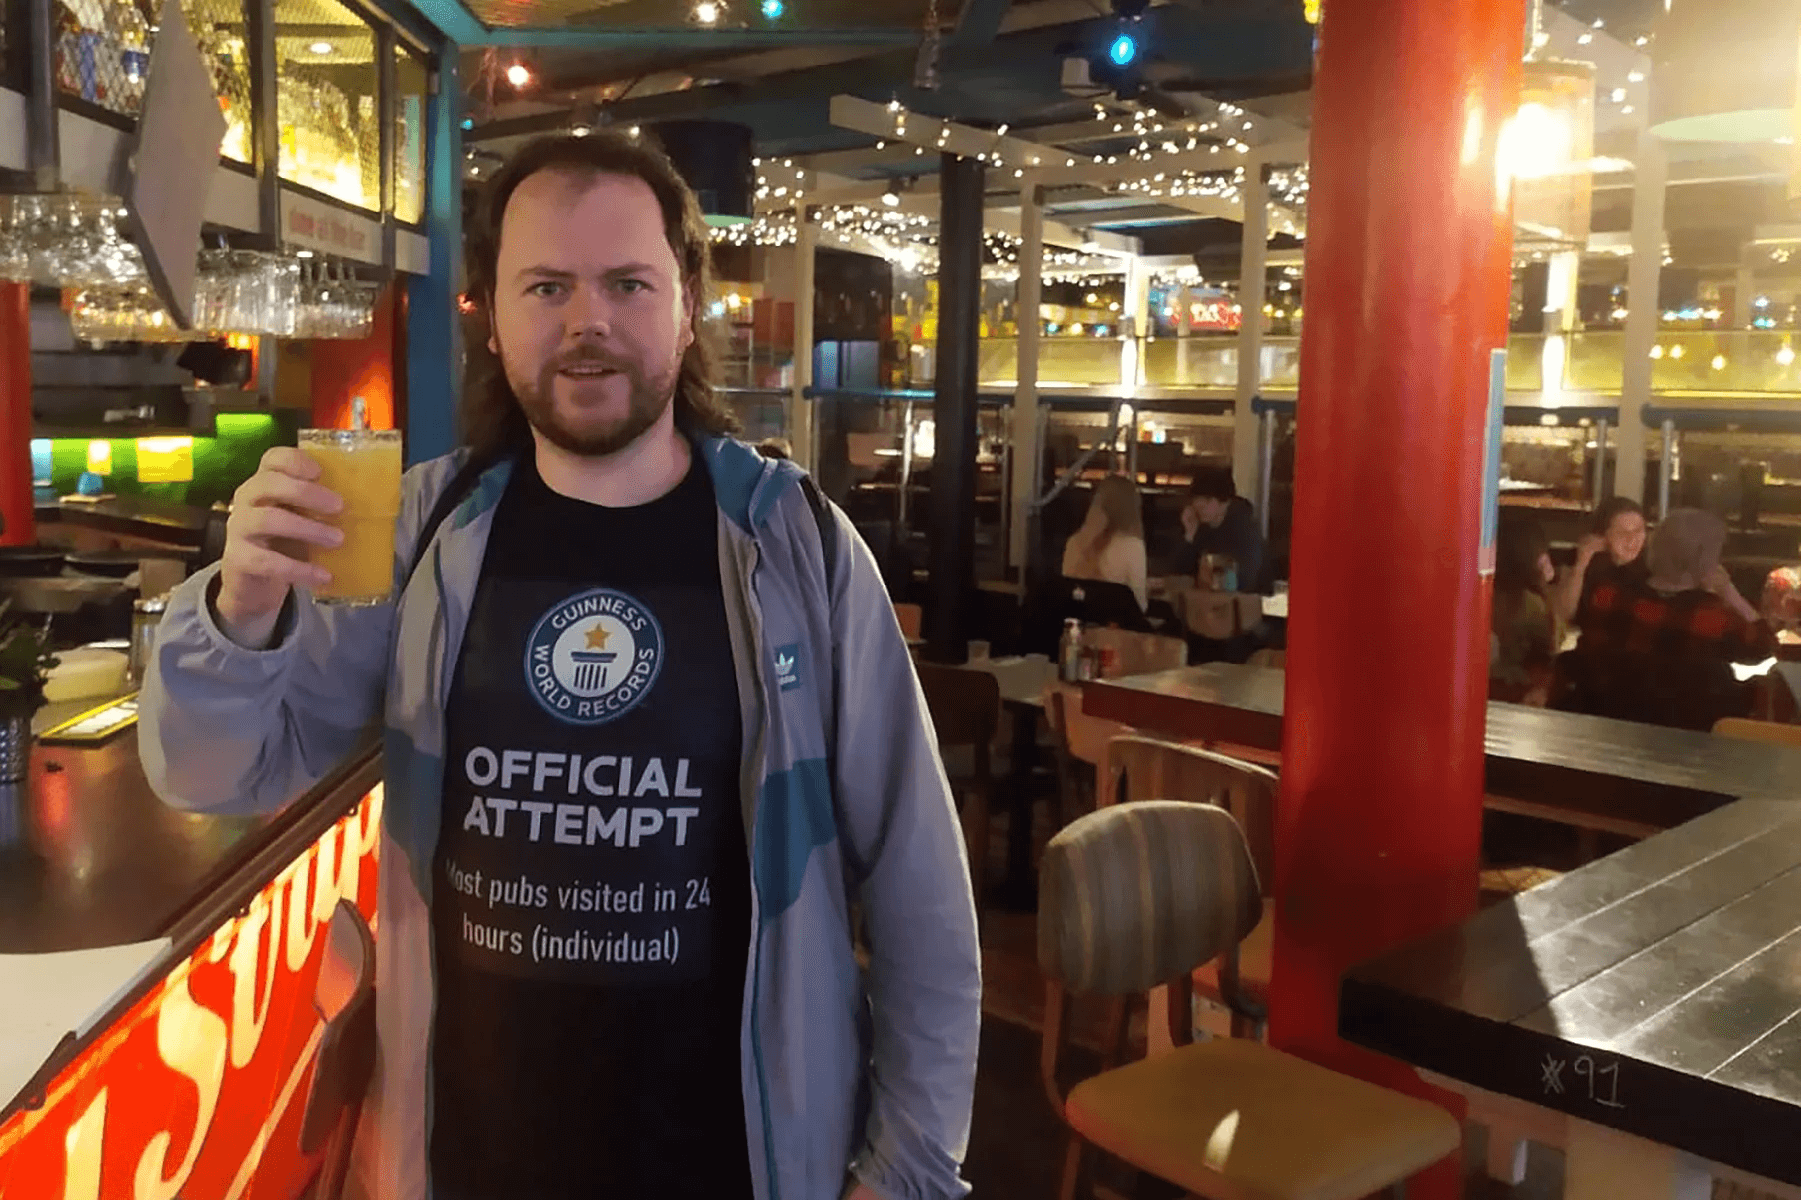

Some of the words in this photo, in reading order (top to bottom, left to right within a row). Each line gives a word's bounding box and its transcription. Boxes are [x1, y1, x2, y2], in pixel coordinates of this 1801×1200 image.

[551, 596, 648, 631] GUINNESS
[533, 643, 572, 710] WORLD
[577, 647, 655, 717] RECORDS
[464, 746, 703, 798] OFFICIAL
[463, 795, 700, 848] ATTEMPT
[488, 874, 549, 910] pubs
[557, 880, 645, 914] visited
[653, 881, 677, 912] in
[684, 876, 711, 910] 24
[462, 912, 523, 955] hours
[532, 923, 680, 965] (individual)
